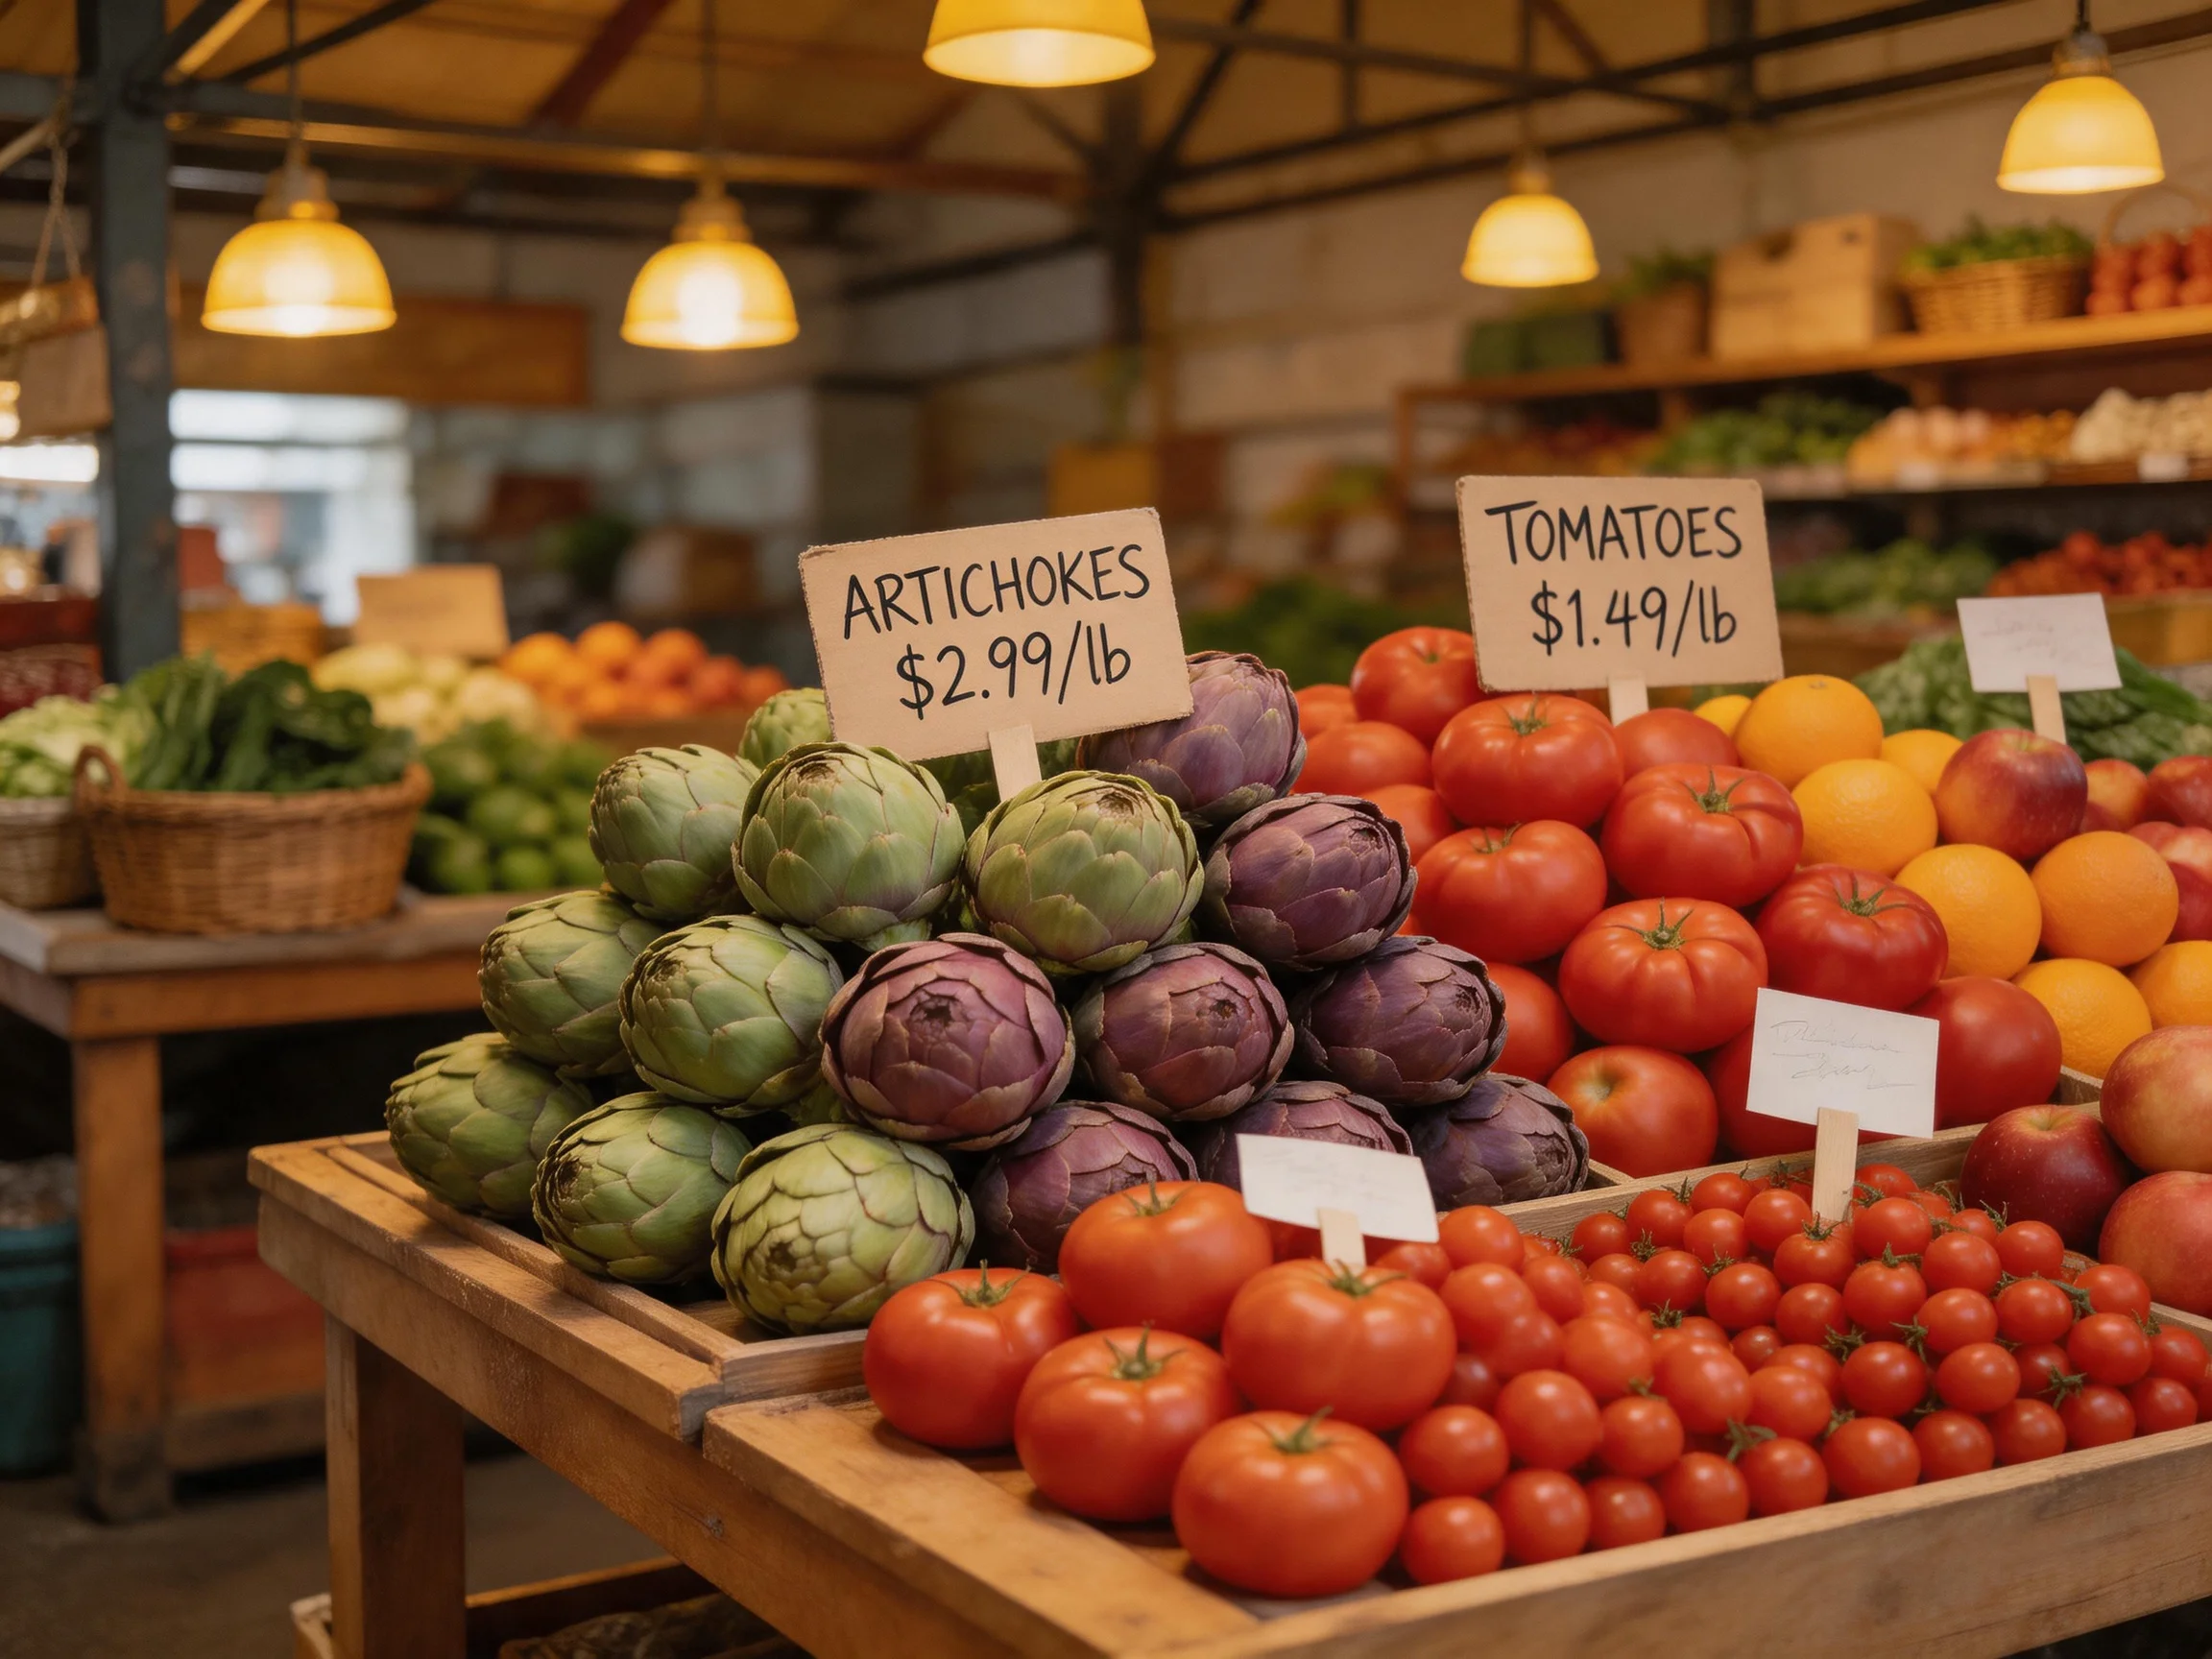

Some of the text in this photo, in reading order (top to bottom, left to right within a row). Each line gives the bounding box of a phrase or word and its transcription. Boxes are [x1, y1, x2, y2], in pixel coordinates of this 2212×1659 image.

[1484, 500, 1743, 565] TOMATOES
[844, 543, 1150, 640] ARTICHOKES
[1530, 579, 1737, 658] $1.49/lb
[896, 619, 1131, 721] $2.99/lb
